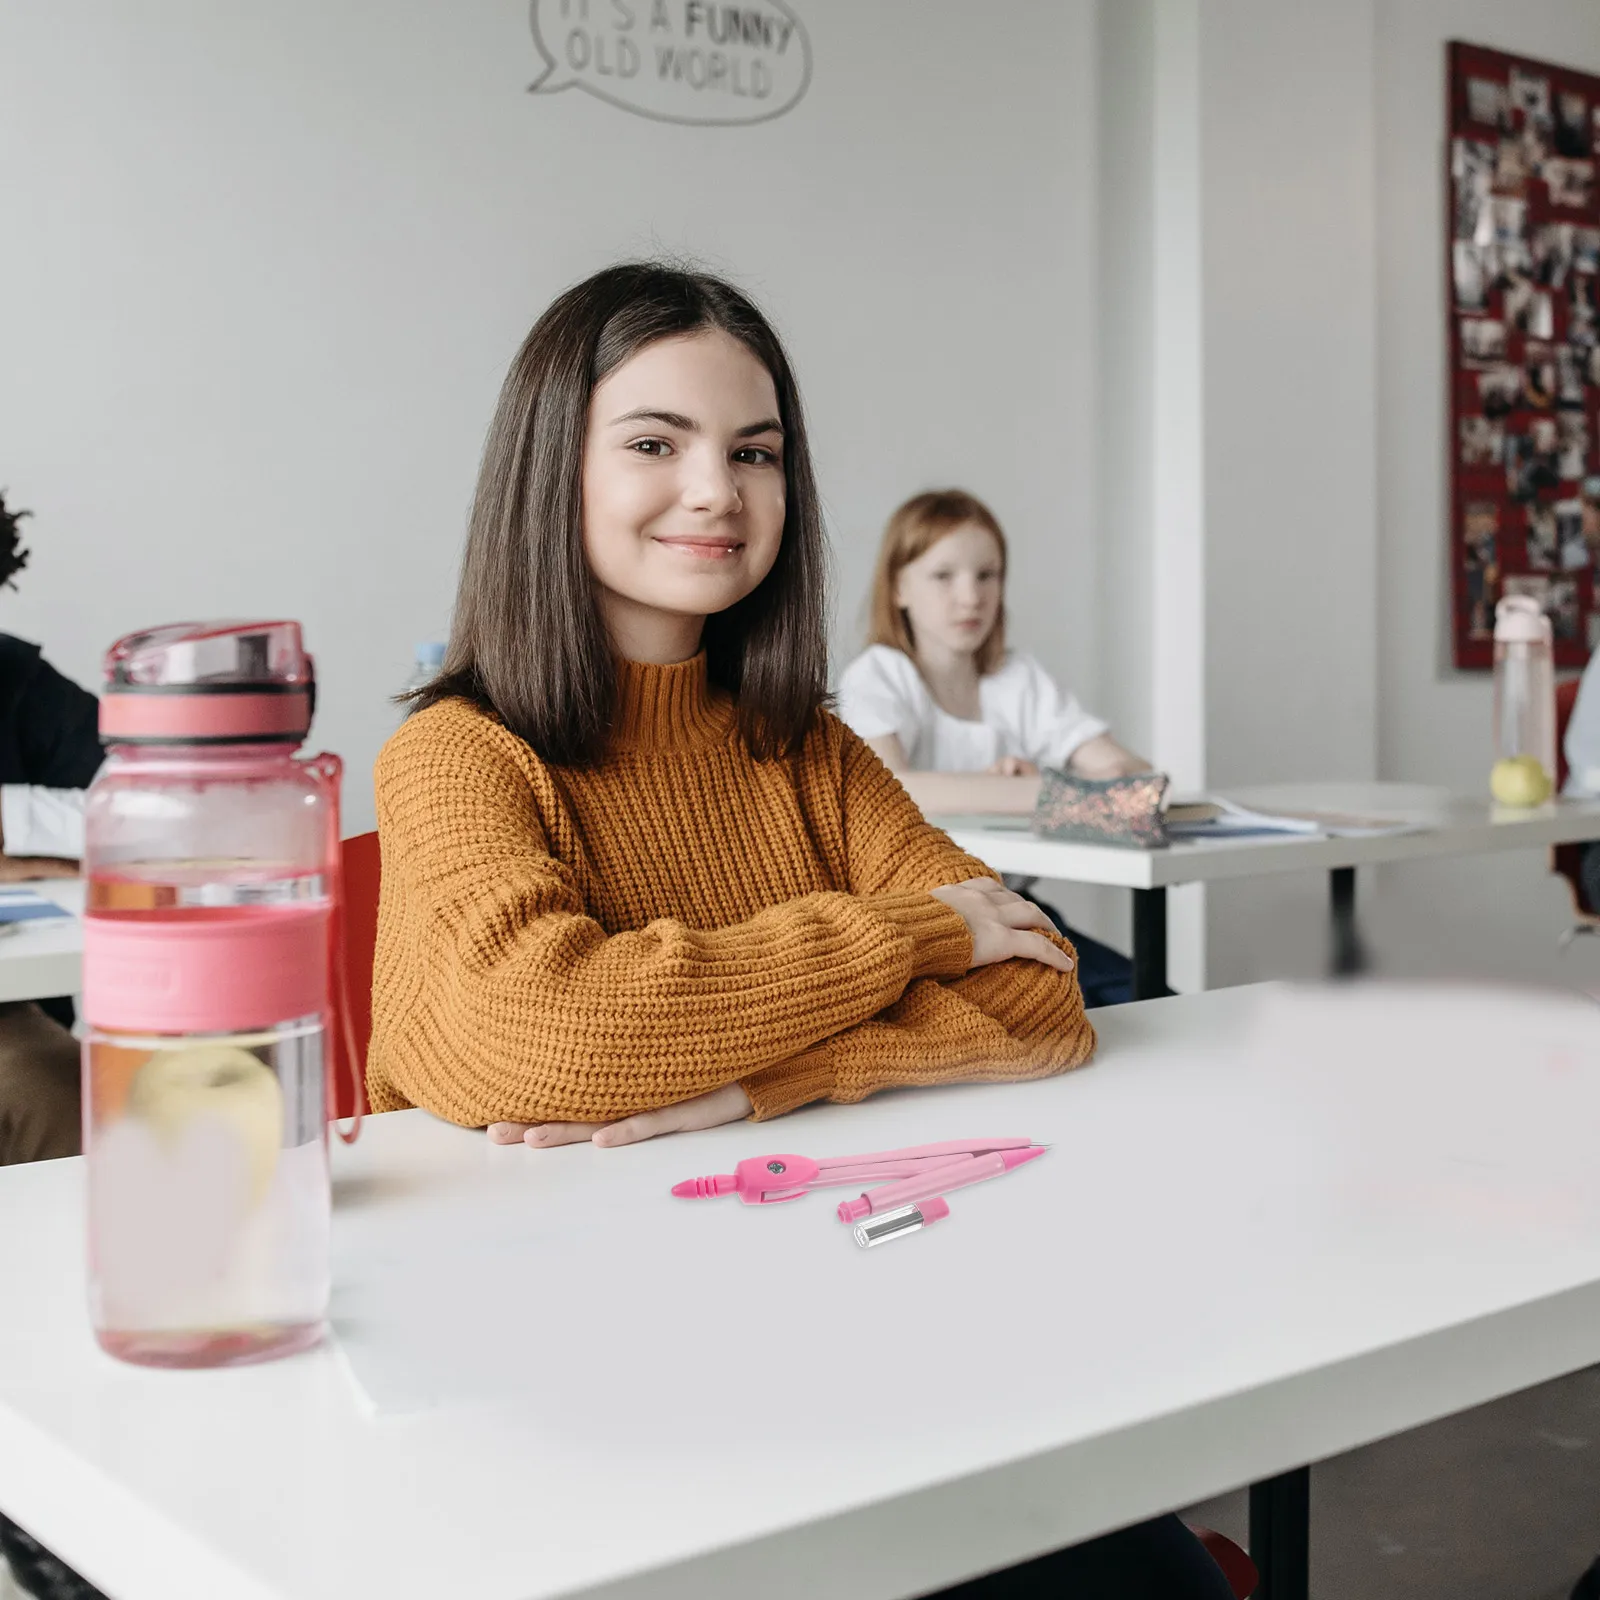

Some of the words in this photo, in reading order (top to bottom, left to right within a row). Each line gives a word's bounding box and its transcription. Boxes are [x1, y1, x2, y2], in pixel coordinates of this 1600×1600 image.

[649, 0, 672, 34] A
[686, 0, 795, 55] FUNNY
[565, 27, 641, 79] OLD
[655, 45, 774, 99] WORLD
